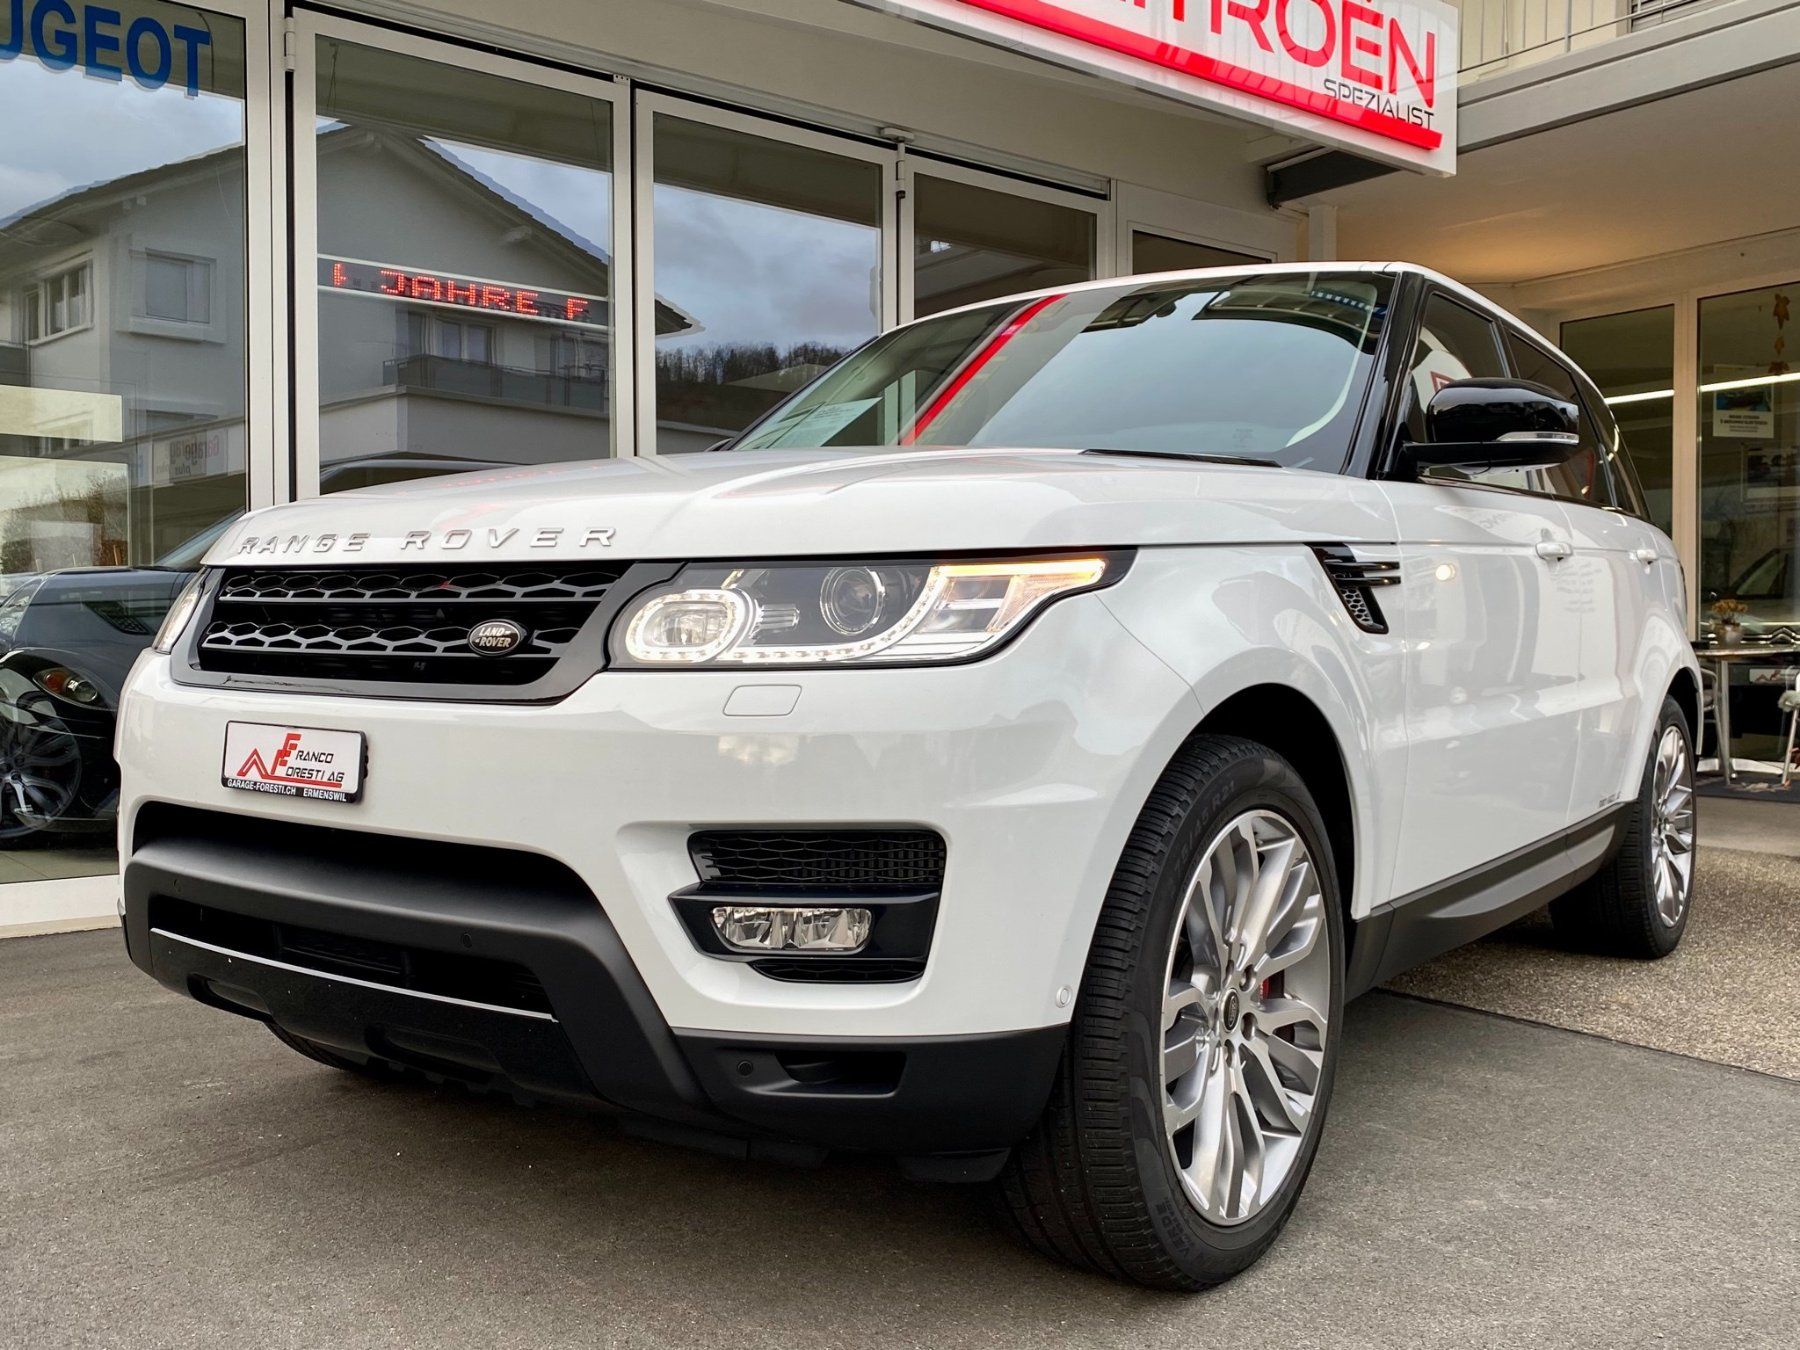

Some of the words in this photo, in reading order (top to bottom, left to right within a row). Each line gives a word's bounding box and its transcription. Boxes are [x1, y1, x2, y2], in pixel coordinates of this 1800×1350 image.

[1119, 0, 1435, 108] ROËN
[1323, 78, 1434, 130] SPEZIALIST
[380, 269, 539, 314] JAHRE
[237, 533, 371, 554] RANGE
[400, 527, 617, 550] ROVER
[479, 627, 506, 637] LAND
[479, 636, 512, 647] ROVER
[328, 771, 345, 783] AG
[227, 779, 297, 796] GARAGE-FORESTI.CH
[303, 787, 347, 802] ERMENSWIL
